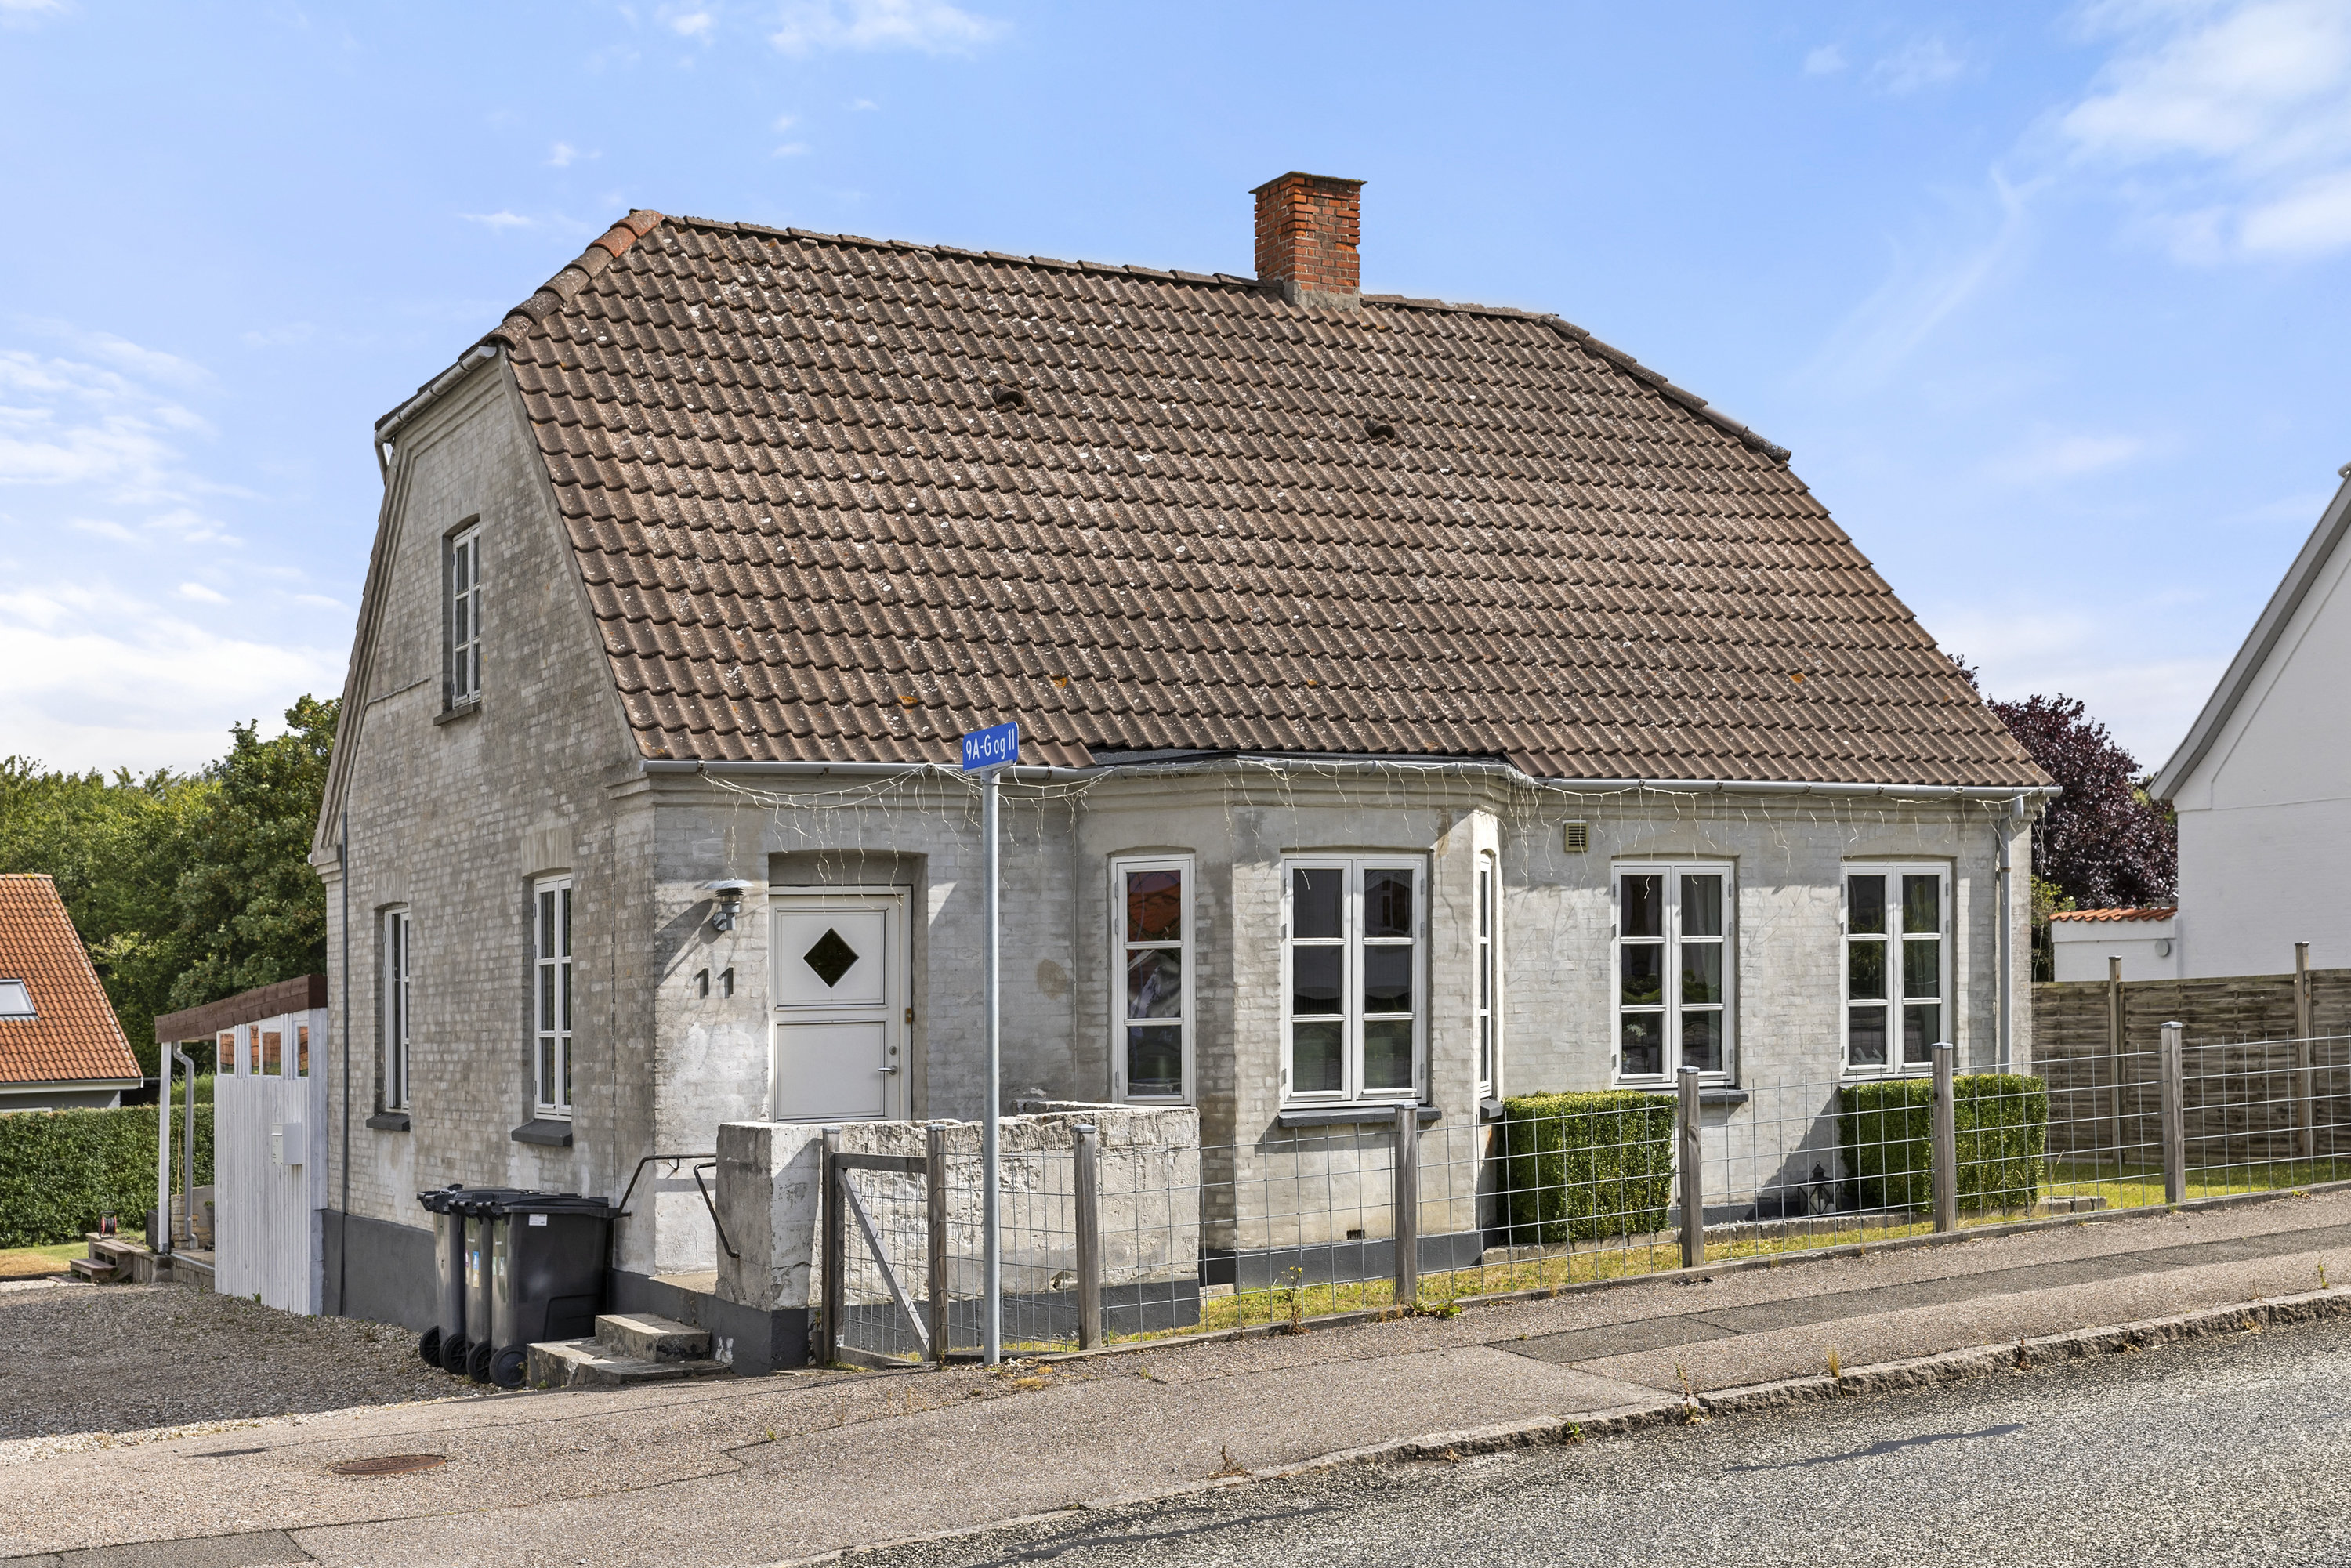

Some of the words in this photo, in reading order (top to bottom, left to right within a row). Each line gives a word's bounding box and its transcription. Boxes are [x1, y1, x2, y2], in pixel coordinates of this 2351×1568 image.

[965, 734, 991, 762] 9A-G
[994, 737, 1005, 760] og
[1008, 728, 1015, 751] 11
[693, 967, 734, 997] 11
